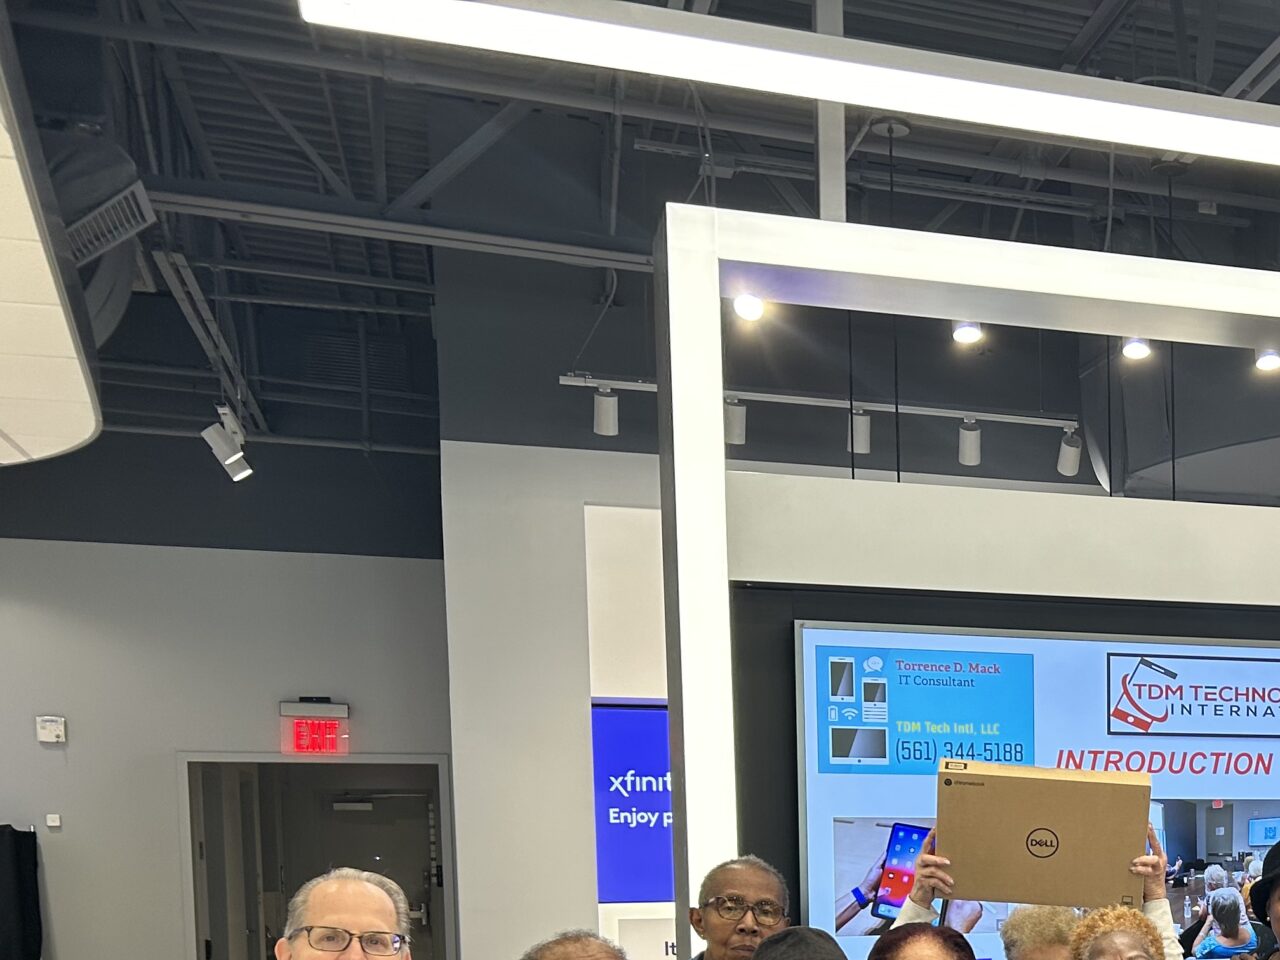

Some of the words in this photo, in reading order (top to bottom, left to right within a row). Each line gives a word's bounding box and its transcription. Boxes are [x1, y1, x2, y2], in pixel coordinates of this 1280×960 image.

[896, 660, 951, 673] Torrence
[953, 662, 966, 673] D.
[968, 663, 1001, 674] Mack
[899, 674, 911, 686] IT
[913, 675, 976, 688] Consultant
[1133, 683, 1184, 701] TDM
[293, 719, 339, 752] EXIT
[896, 720, 921, 733] TDM
[925, 721, 950, 734] Tech
[981, 723, 1000, 735] LLC
[896, 738, 937, 764] (561)
[943, 741, 1024, 762] 344-5188
[1056, 749, 1273, 776] INTRODUCTION
[609, 807, 659, 828] Enjoy
[1030, 839, 1055, 848] DELL
